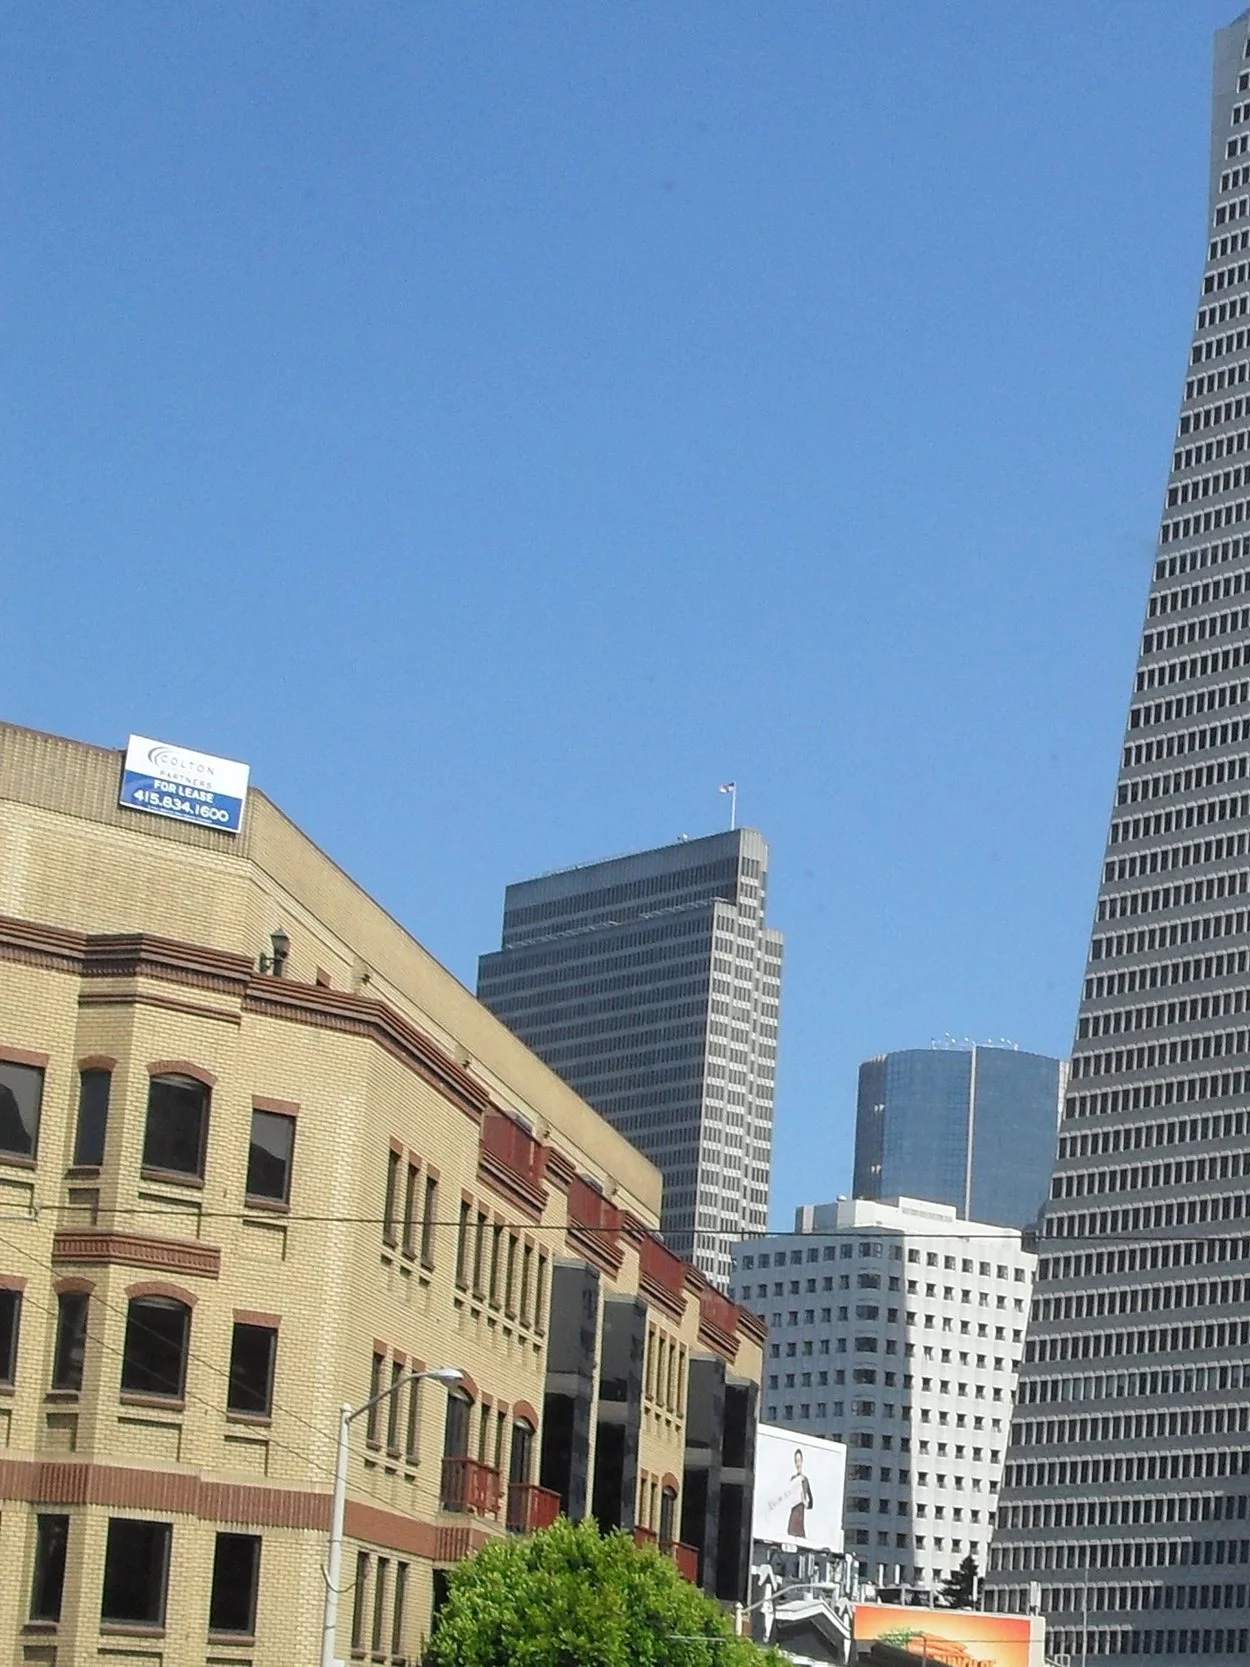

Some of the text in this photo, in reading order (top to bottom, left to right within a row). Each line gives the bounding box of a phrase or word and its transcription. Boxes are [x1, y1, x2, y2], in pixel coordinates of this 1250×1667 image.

[160, 754, 215, 775] COLTON
[159, 770, 212, 789] PARTNERS
[153, 780, 215, 803] FOR LEASE
[133, 789, 230, 823] 415.834.1600
